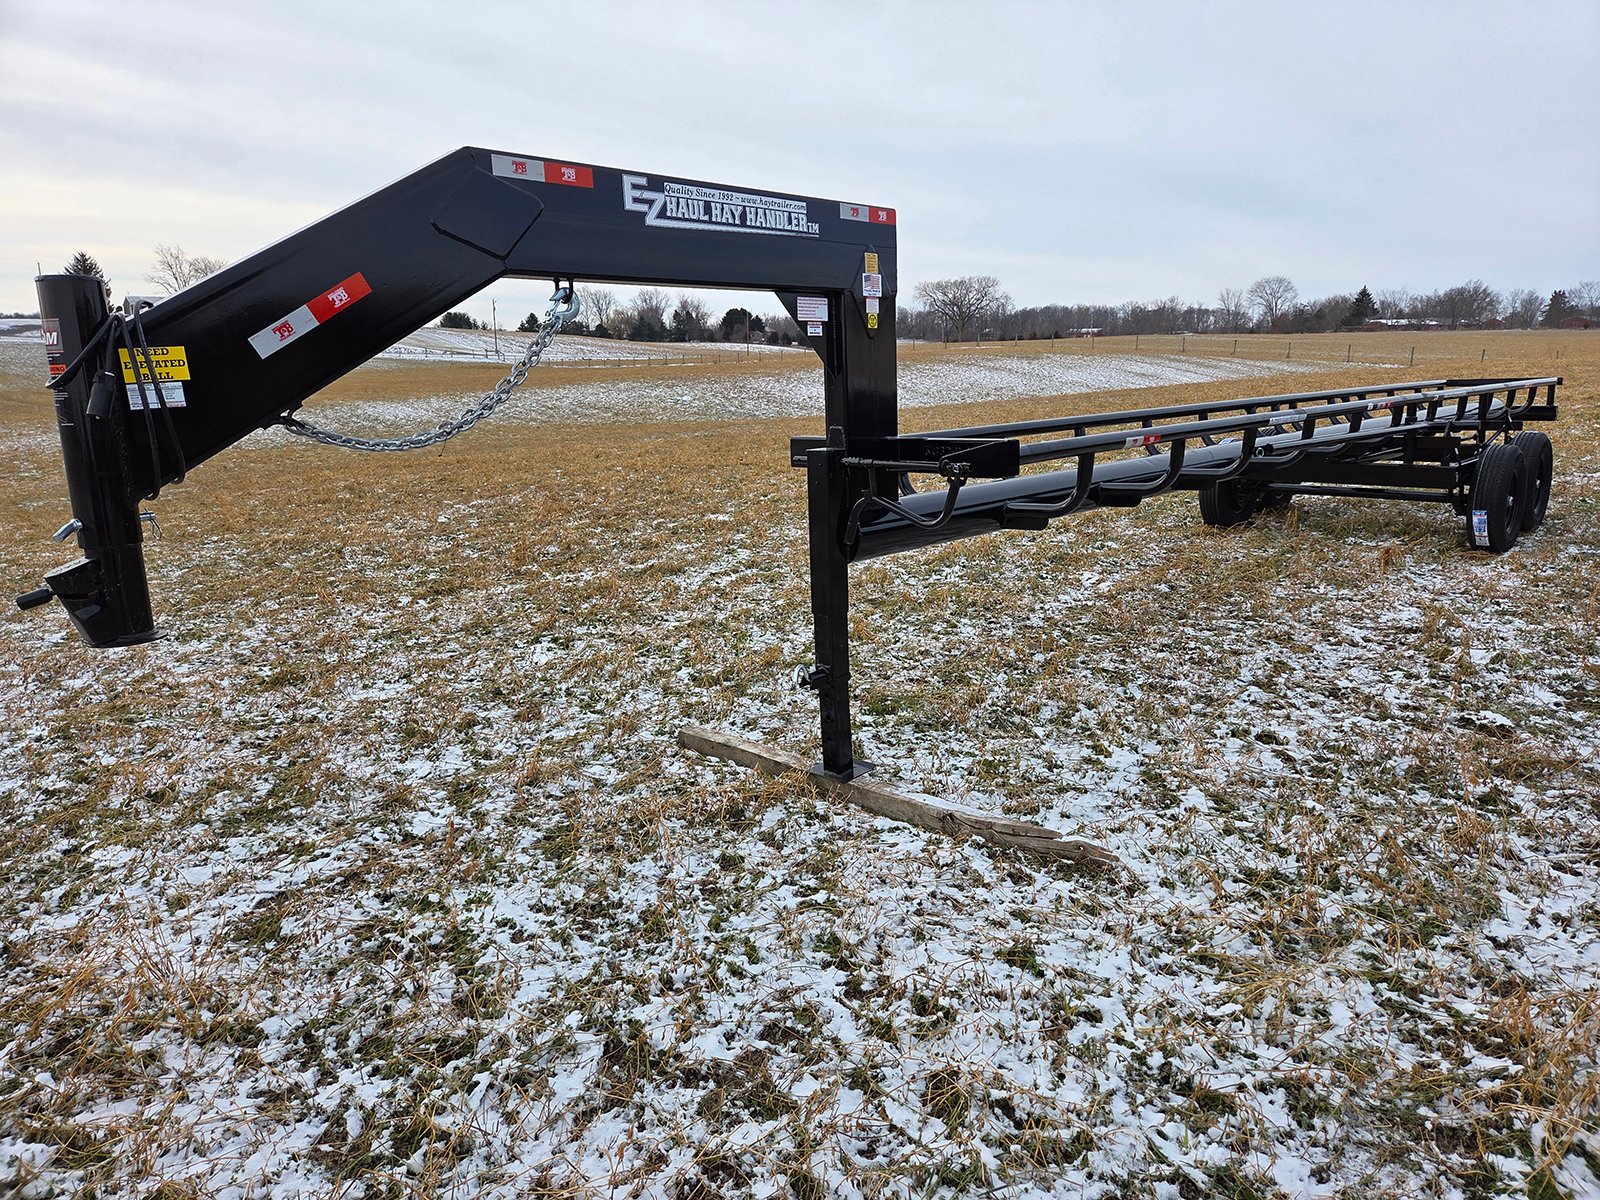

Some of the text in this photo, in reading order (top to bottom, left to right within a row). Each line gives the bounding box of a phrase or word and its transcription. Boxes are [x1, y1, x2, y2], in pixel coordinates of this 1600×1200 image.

[664, 184, 693, 197] Quality
[695, 187, 716, 199] Since
[717, 192, 734, 202] 1992
[740, 196, 806, 210] www.haytrailer.com
[666, 197, 710, 221] HAUL
[711, 202, 743, 225] HAY
[123, 359, 185, 370] EEATED
[142, 372, 174, 381] BLL
